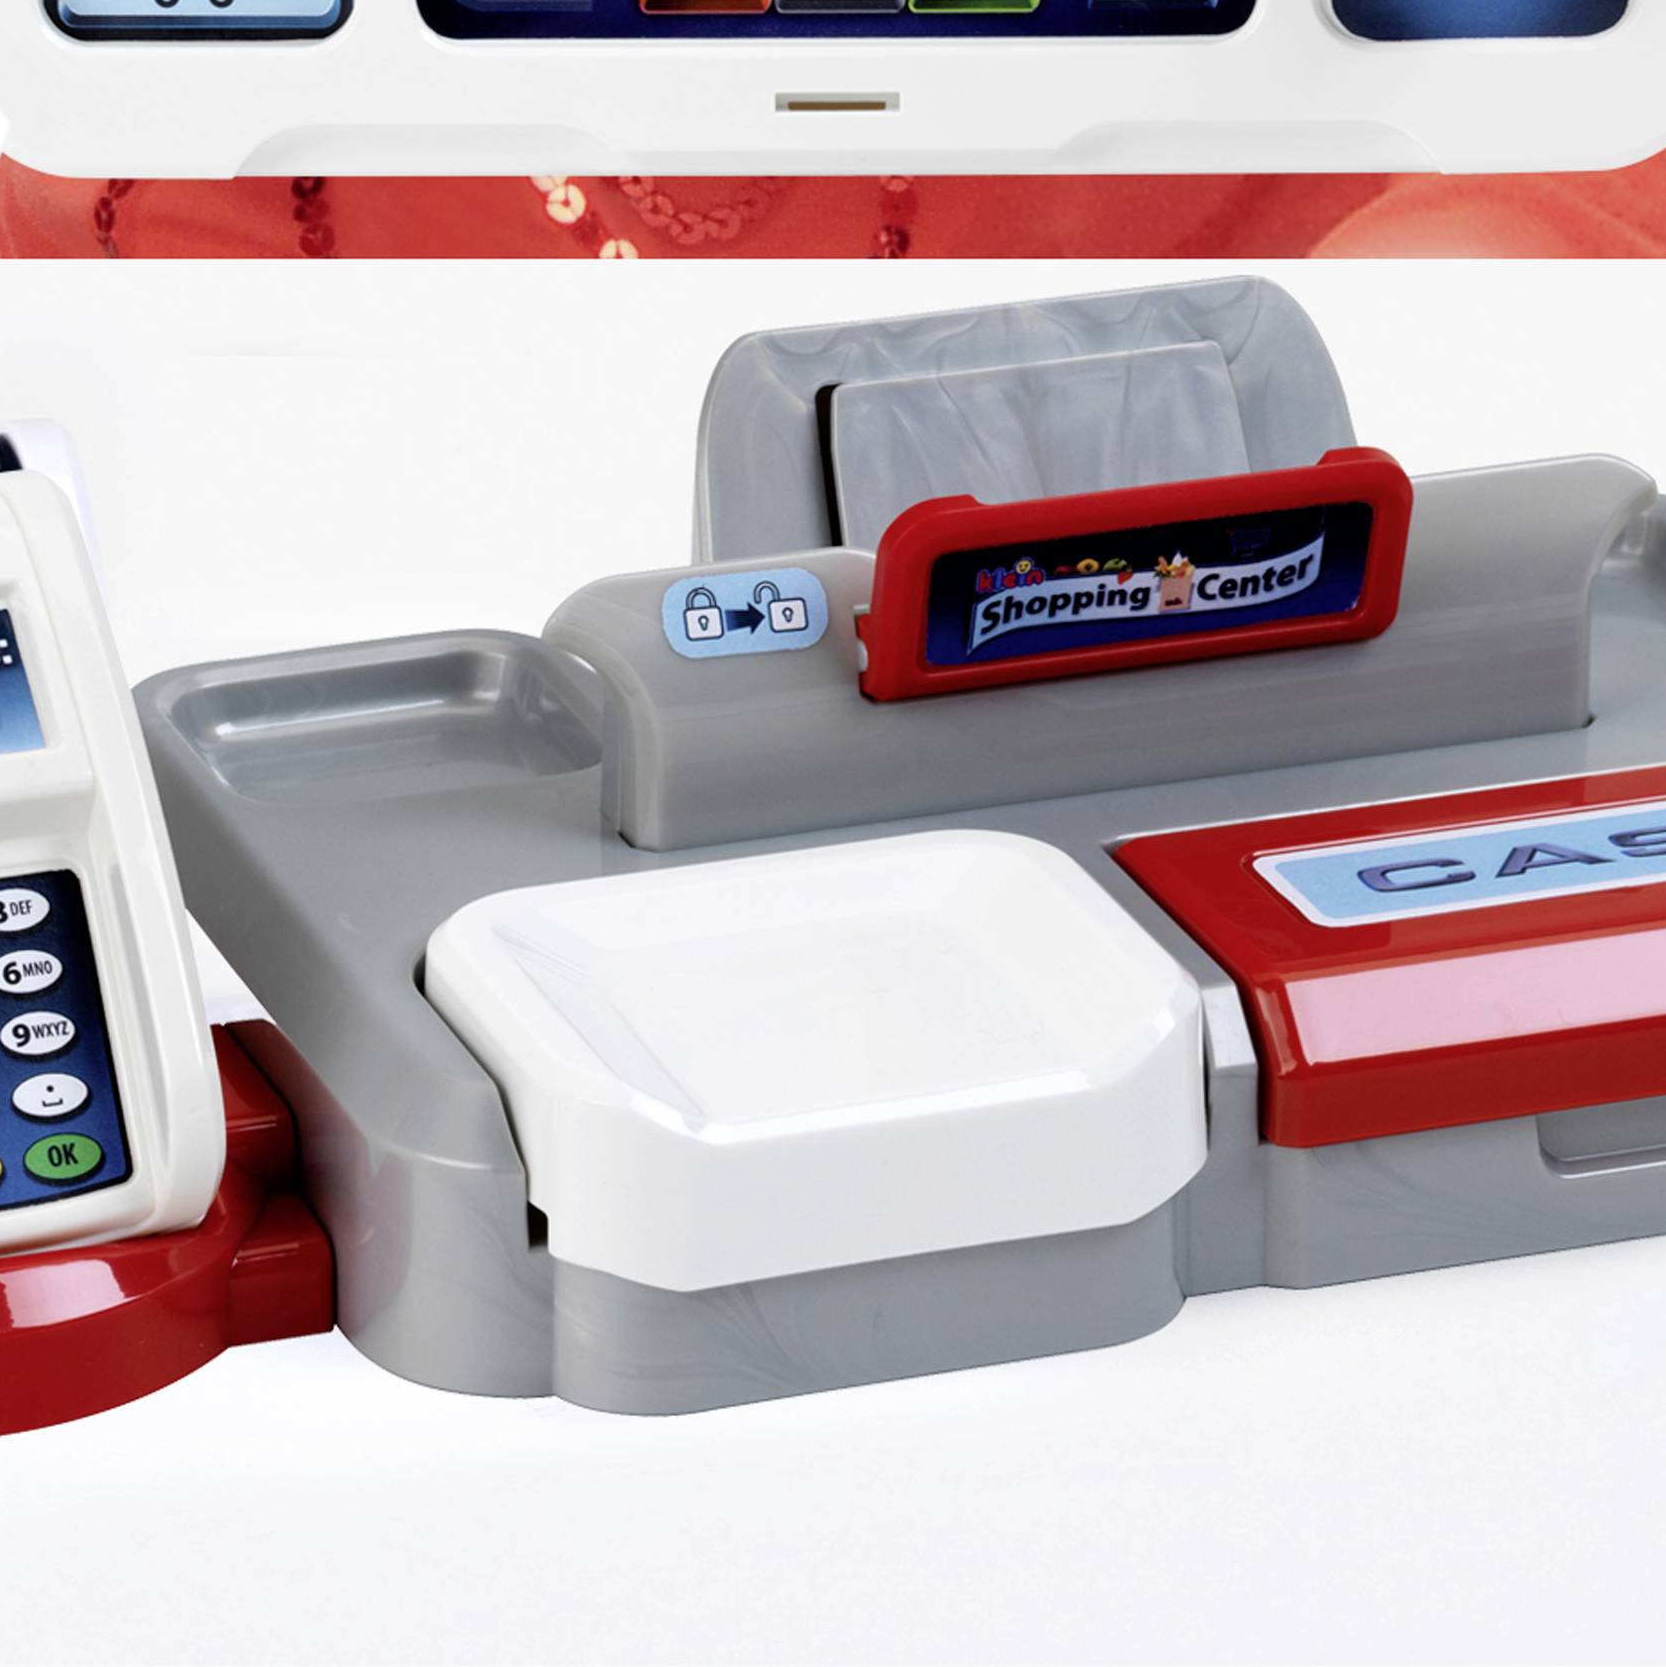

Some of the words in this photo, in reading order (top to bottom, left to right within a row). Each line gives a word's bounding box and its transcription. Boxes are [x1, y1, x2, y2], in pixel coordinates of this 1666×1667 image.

[980, 584, 1151, 634] Shopping
[1196, 553, 1314, 601] Center
[48, 1143, 78, 1167] OK
